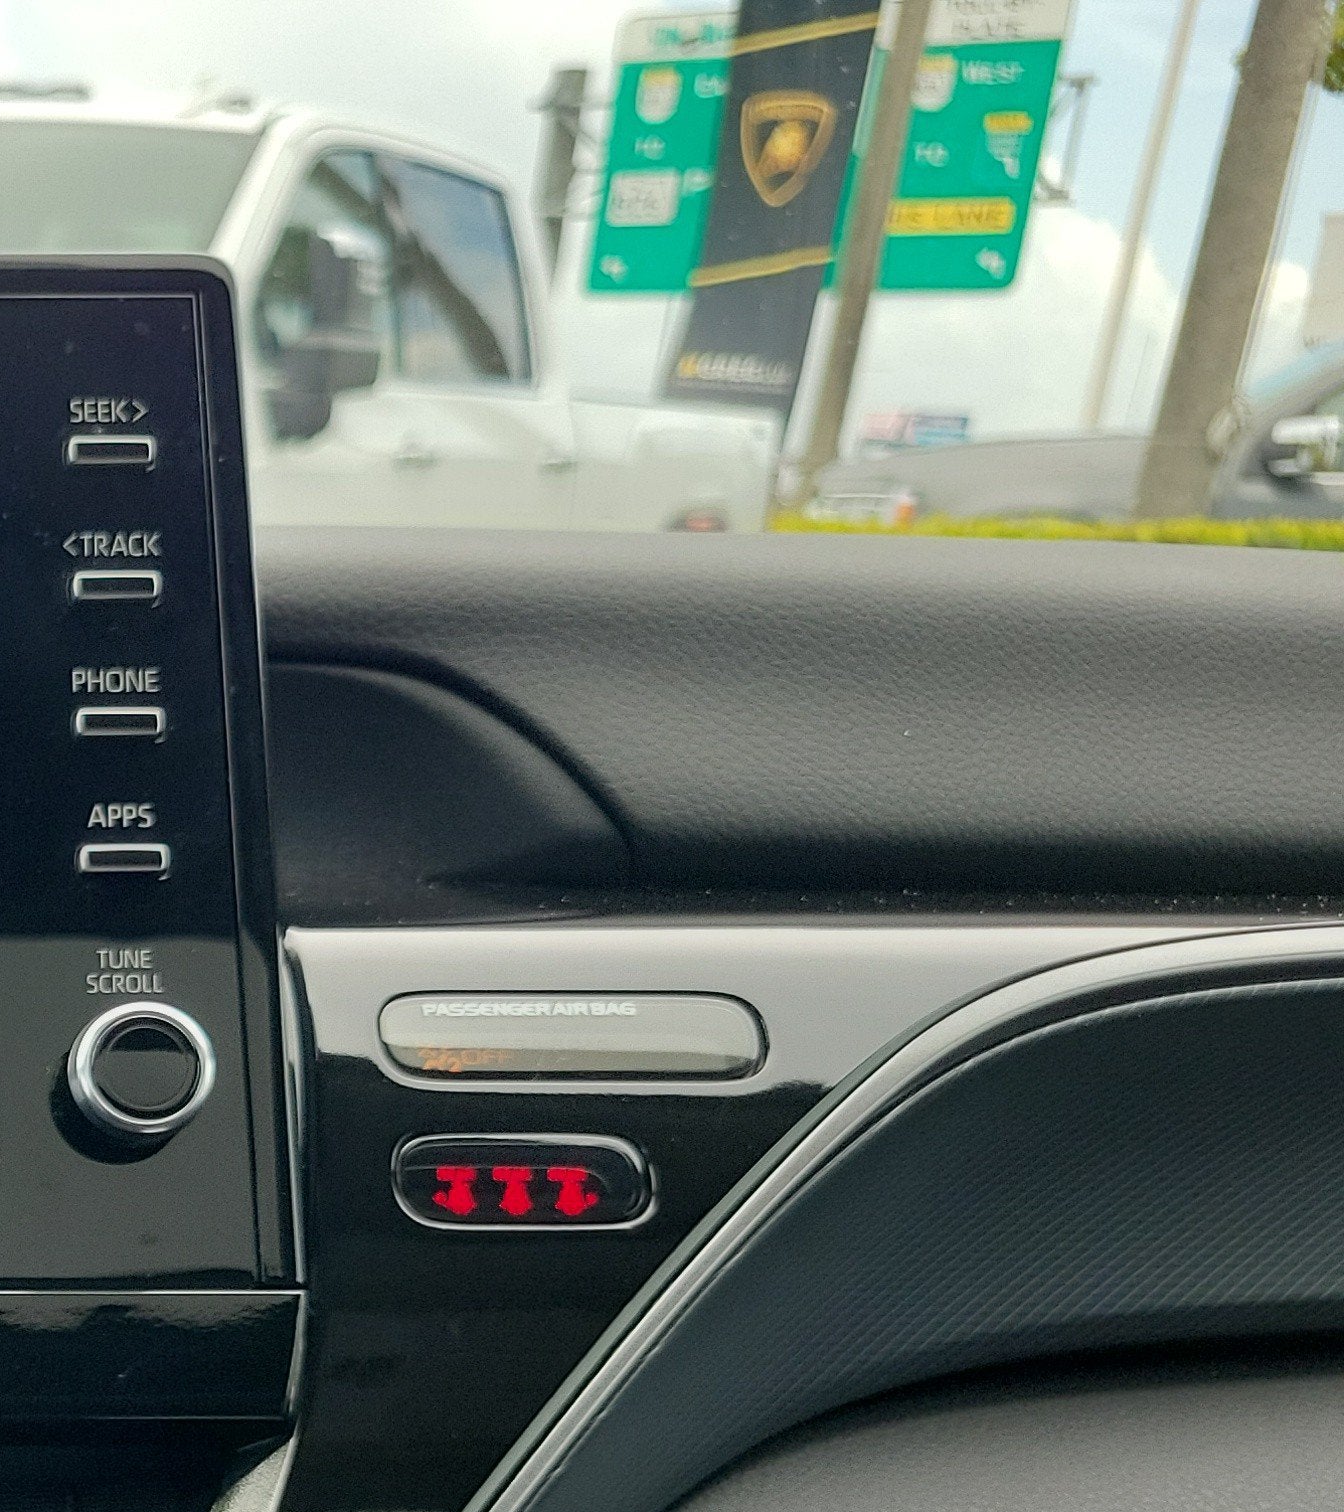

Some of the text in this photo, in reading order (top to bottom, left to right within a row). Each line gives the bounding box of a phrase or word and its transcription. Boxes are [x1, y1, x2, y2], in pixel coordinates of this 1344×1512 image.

[72, 669, 161, 693] PHONE
[87, 803, 156, 828] APPS
[96, 950, 153, 969] TUNE
[86, 975, 163, 994] SCROLL
[421, 1003, 552, 1017] PASSENGER
